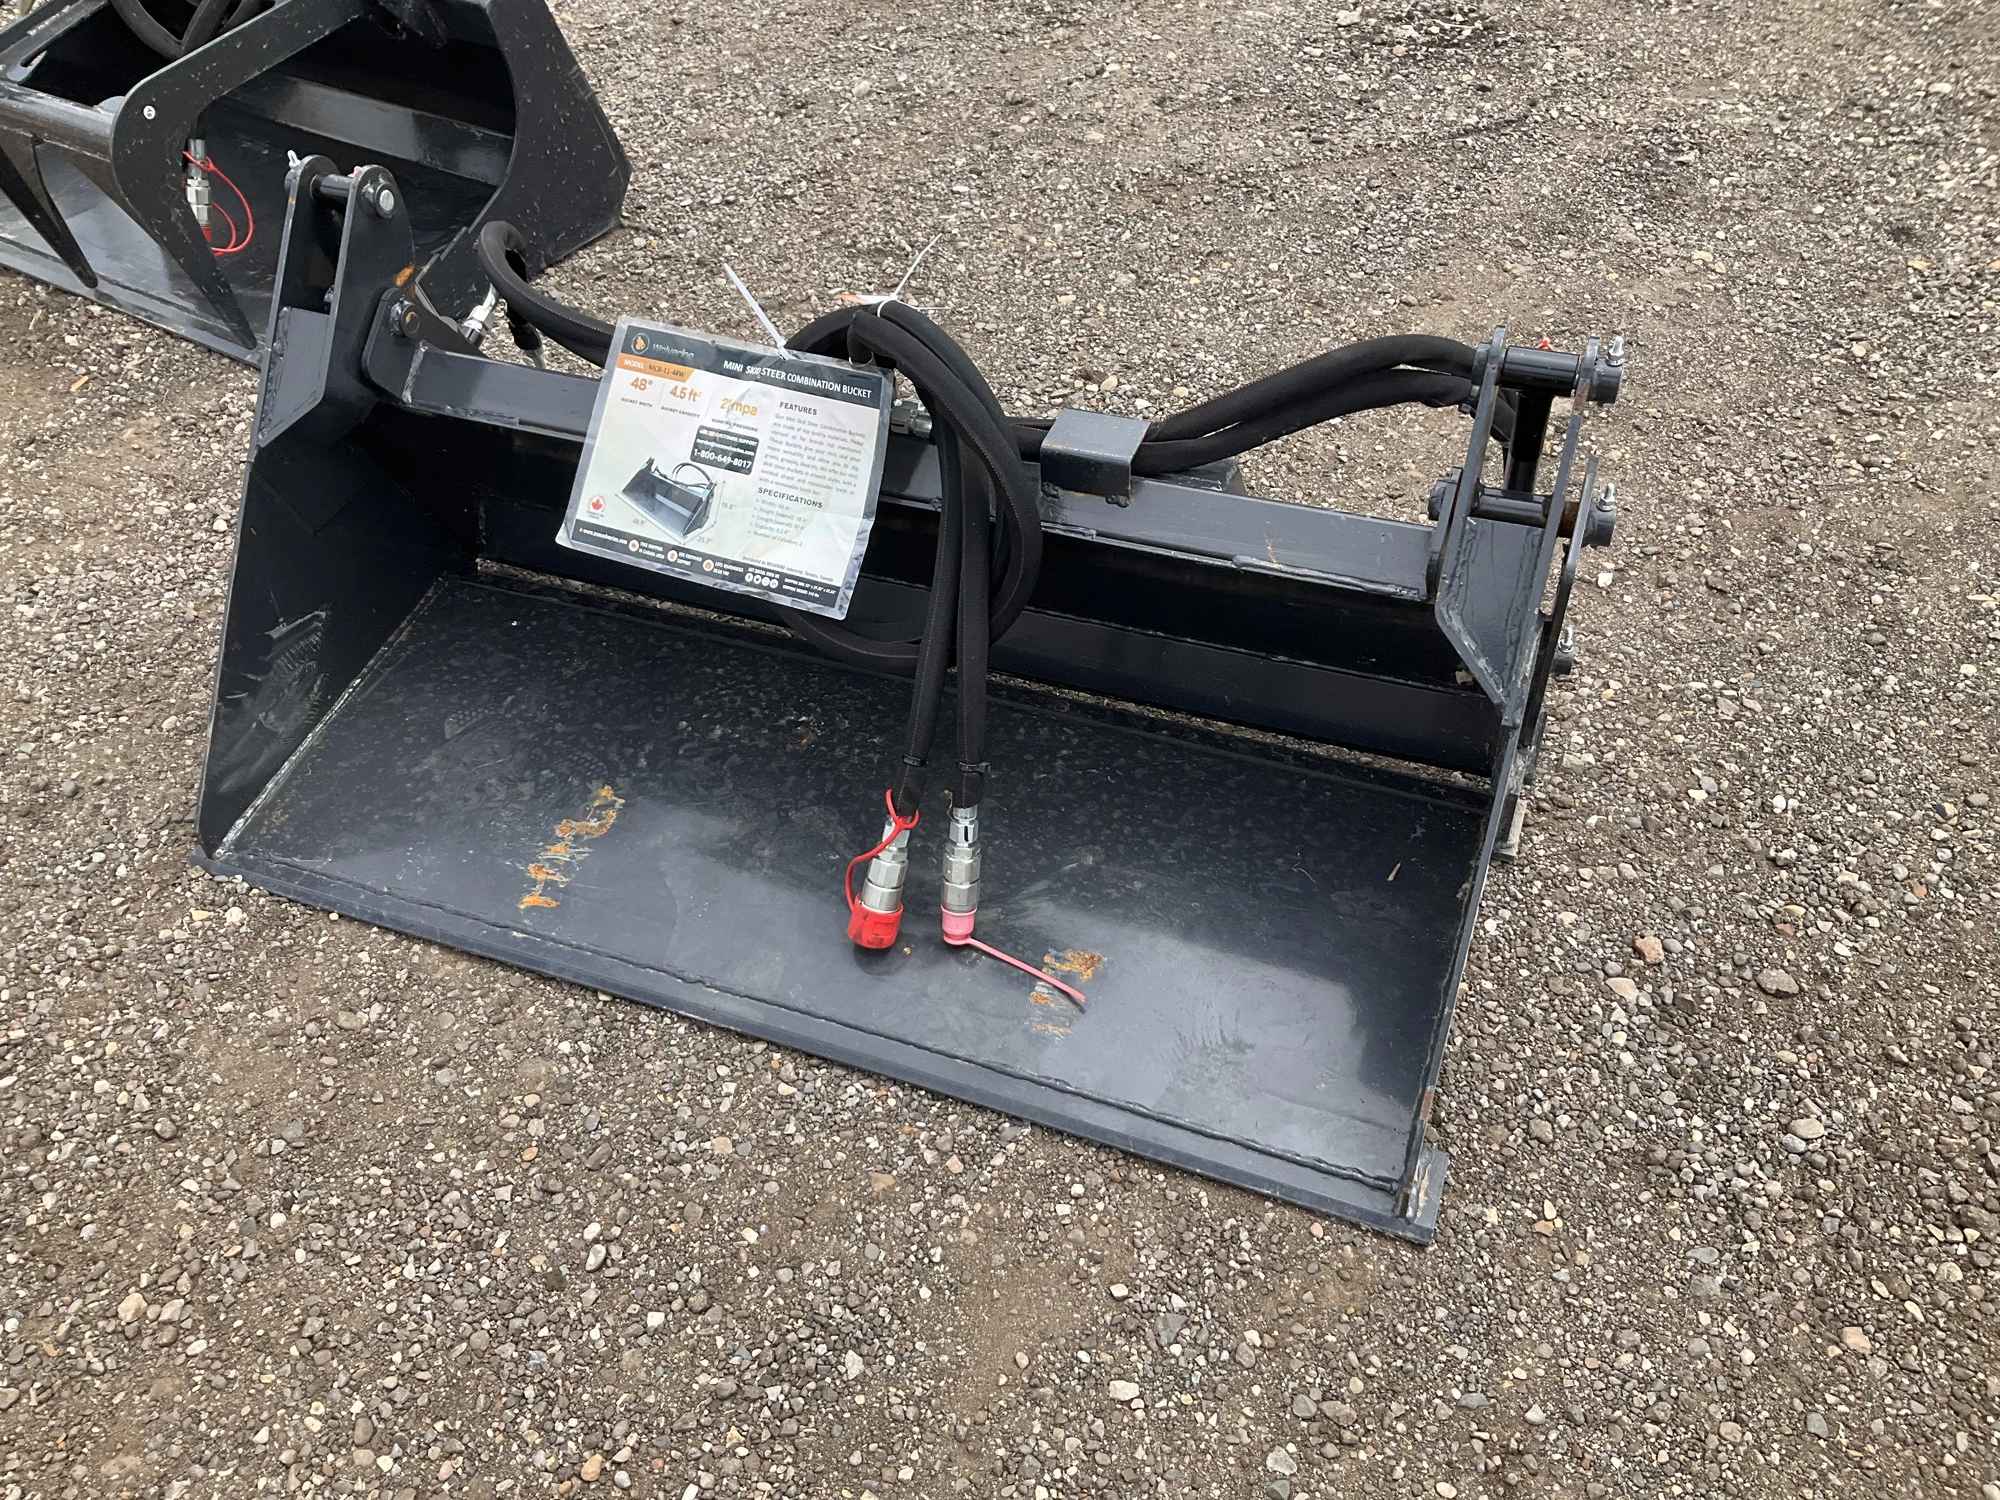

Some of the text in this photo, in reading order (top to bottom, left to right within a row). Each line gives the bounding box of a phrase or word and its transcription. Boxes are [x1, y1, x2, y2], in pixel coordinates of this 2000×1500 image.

[652, 343, 695, 360] Wolverine
[623, 359, 645, 369] MODEL
[723, 360, 872, 399] MINI SKID STEER COMBINATION BUCKET
[669, 385, 688, 400] 4.5
[661, 406, 700, 419] BUCKET CAPACITY
[779, 402, 818, 416] FEATURES
[712, 418, 758, 432] WORKING PRESSURE
[820, 424, 847, 434] Combination
[848, 430, 866, 438] Buckets
[715, 432, 758, 446] CUSTOMER SUPPORT
[811, 430, 826, 438] quality
[769, 437, 784, 445] These
[785, 441, 803, 449] buckets
[771, 430, 789, 438] contact
[809, 438, 824, 446] brands
[837, 445, 863, 455] mentioned.
[693, 449, 752, 469] 1-800-649-8017
[782, 449, 805, 459] versatility
[761, 469, 779, 477] welded
[807, 480, 834, 491] replaceable
[787, 467, 804, 475] buckets
[810, 472, 827, 480] smooth
[774, 481, 799, 490] removable
[757, 487, 823, 509] SPECIFICATIONS
[759, 508, 775, 516] Height
[757, 515, 773, 524] Length
[753, 531, 772, 539] Number
[648, 544, 663, 552] SHIPPING
[685, 554, 703, 562] CUSTOMER
[742, 555, 761, 564] Distributed
[766, 562, 785, 570] WOLVERINE
[723, 563, 744, 573] WAREHOUSES
